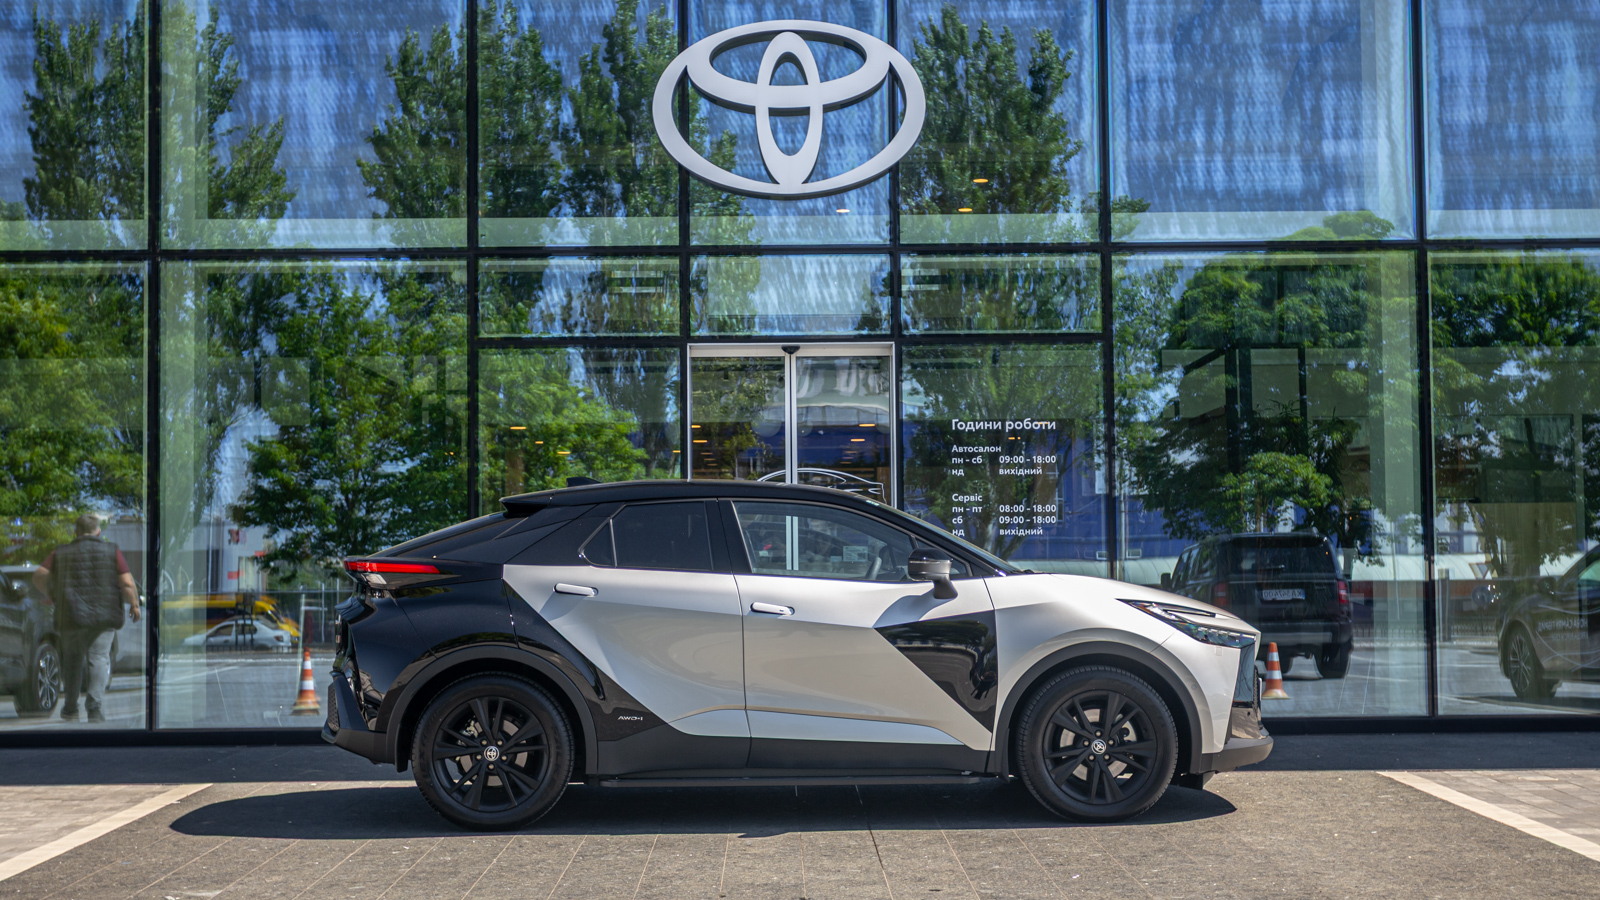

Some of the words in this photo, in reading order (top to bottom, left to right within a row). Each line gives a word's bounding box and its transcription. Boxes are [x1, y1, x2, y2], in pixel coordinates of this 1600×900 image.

[951, 419, 1002, 432] Години
[1005, 418, 1056, 432] роботи
[951, 445, 1002, 453] Автосалон
[971, 455, 983, 464] сб
[998, 455, 1025, 464] 09:00
[1032, 455, 1057, 464] 18:00
[998, 467, 1043, 476] вихідний
[951, 493, 983, 503] Сервіс
[999, 504, 1025, 513] 08:00
[1032, 504, 1057, 513] 18:00
[951, 515, 963, 524] сб
[998, 515, 1025, 524] 09:00
[1032, 515, 1057, 524] 18:00
[999, 527, 1043, 536] вихідний
